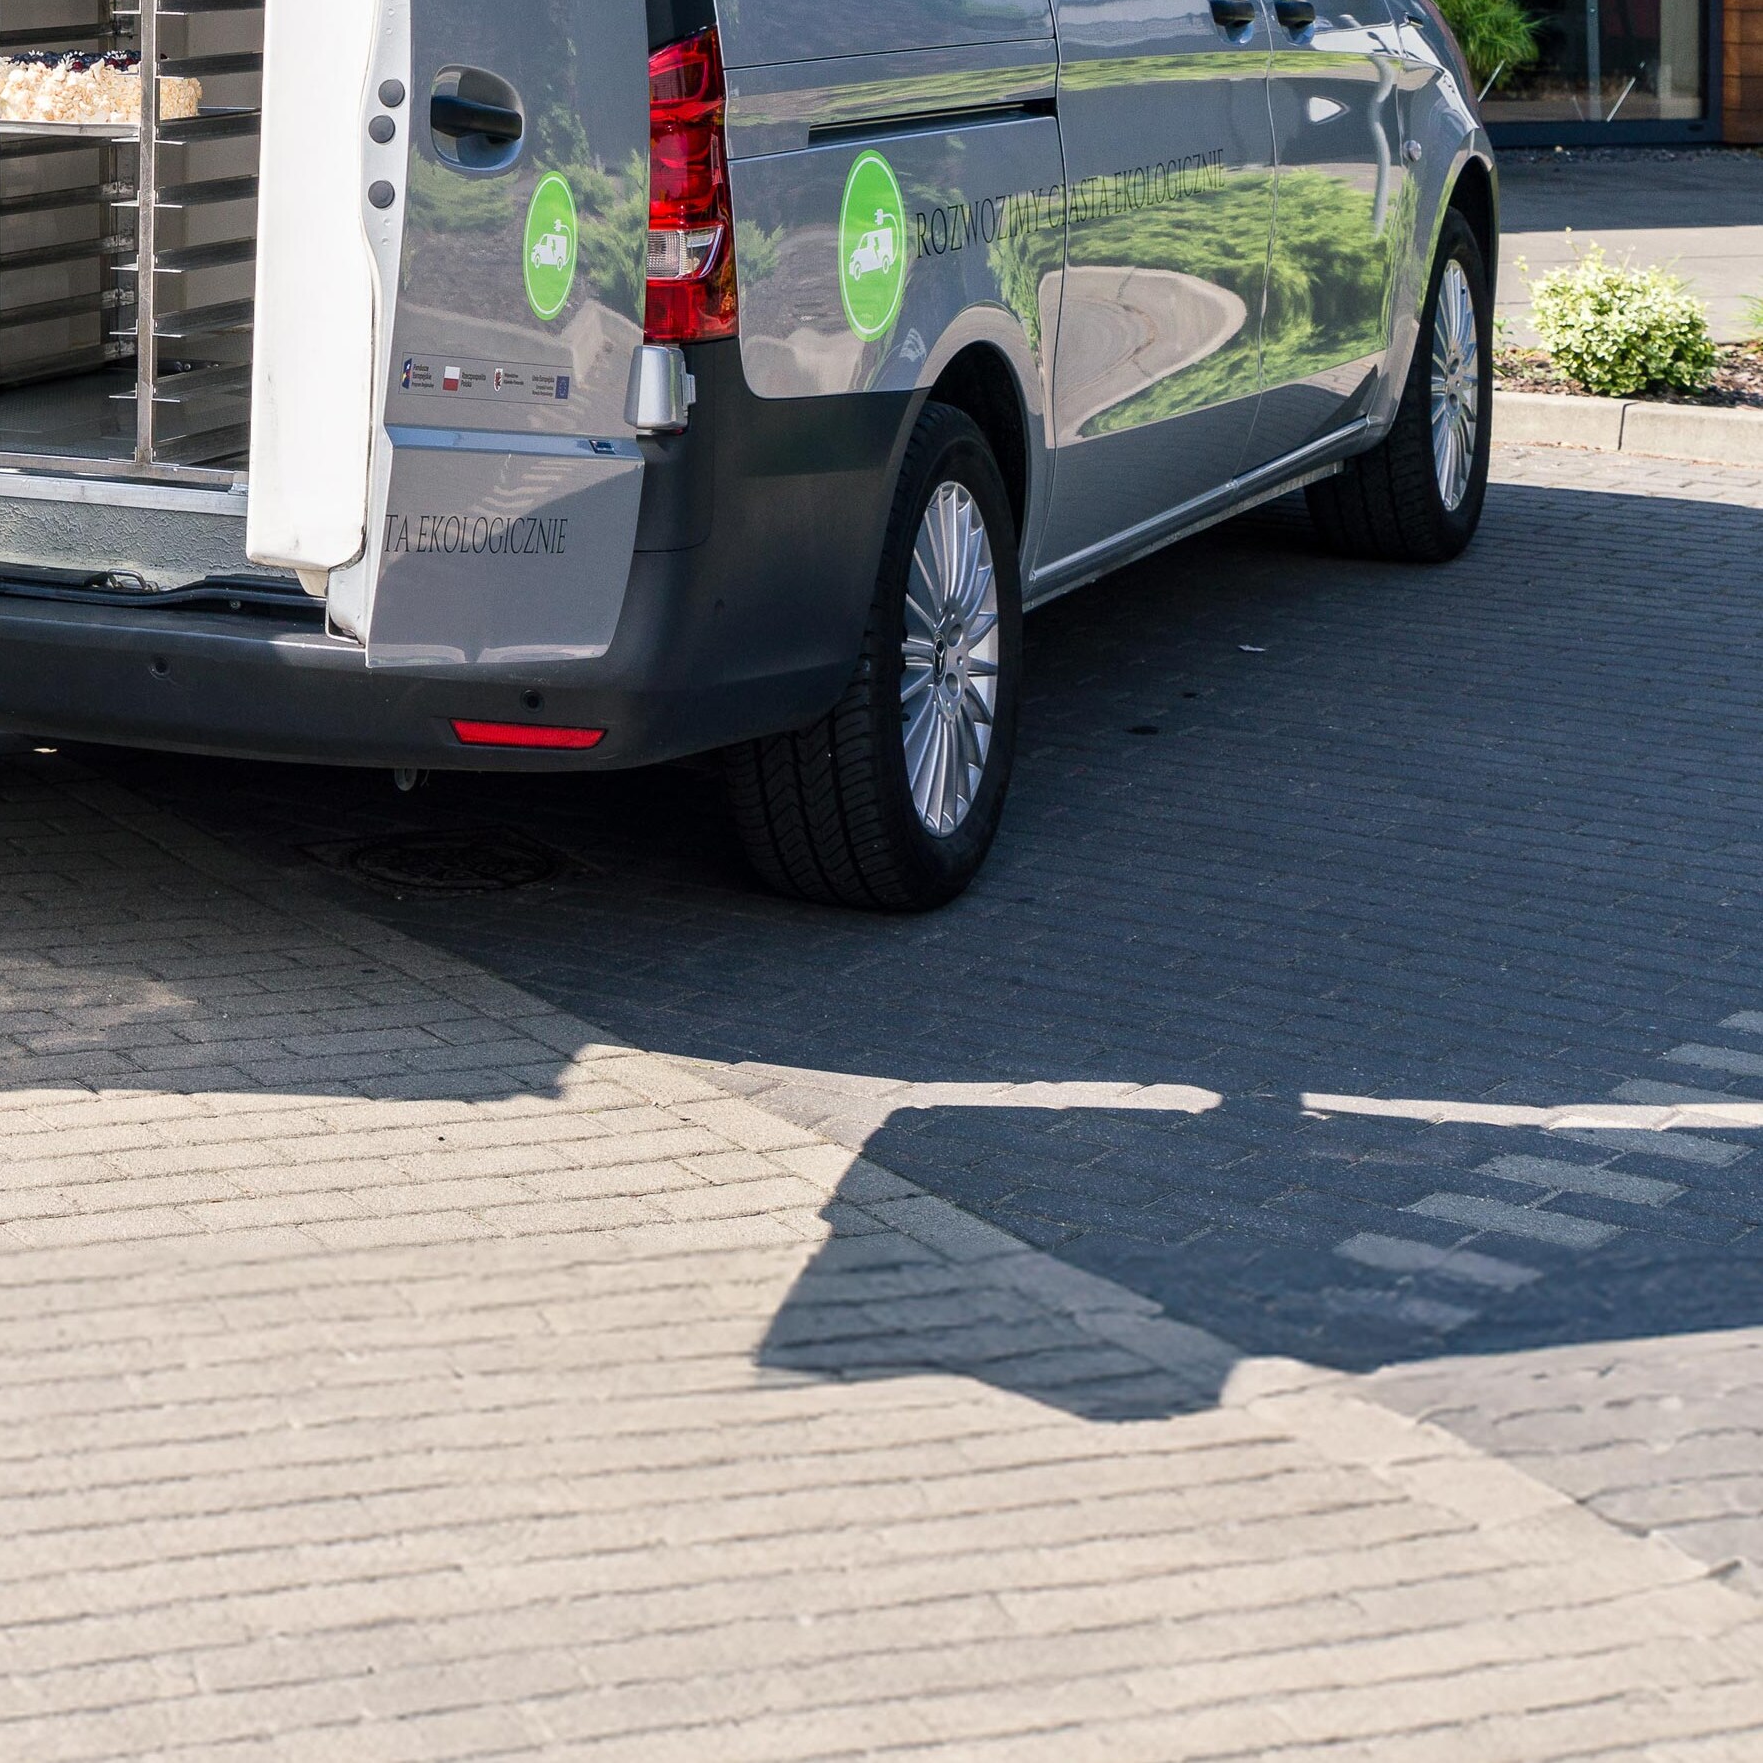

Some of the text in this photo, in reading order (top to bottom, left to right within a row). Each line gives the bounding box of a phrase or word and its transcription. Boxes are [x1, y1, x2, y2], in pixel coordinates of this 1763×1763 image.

[916, 188, 1043, 259] ROZWOZIMY
[1114, 149, 1225, 214] EKOLOGICZNIE
[416, 515, 568, 554] EKOLOGICZNIE
